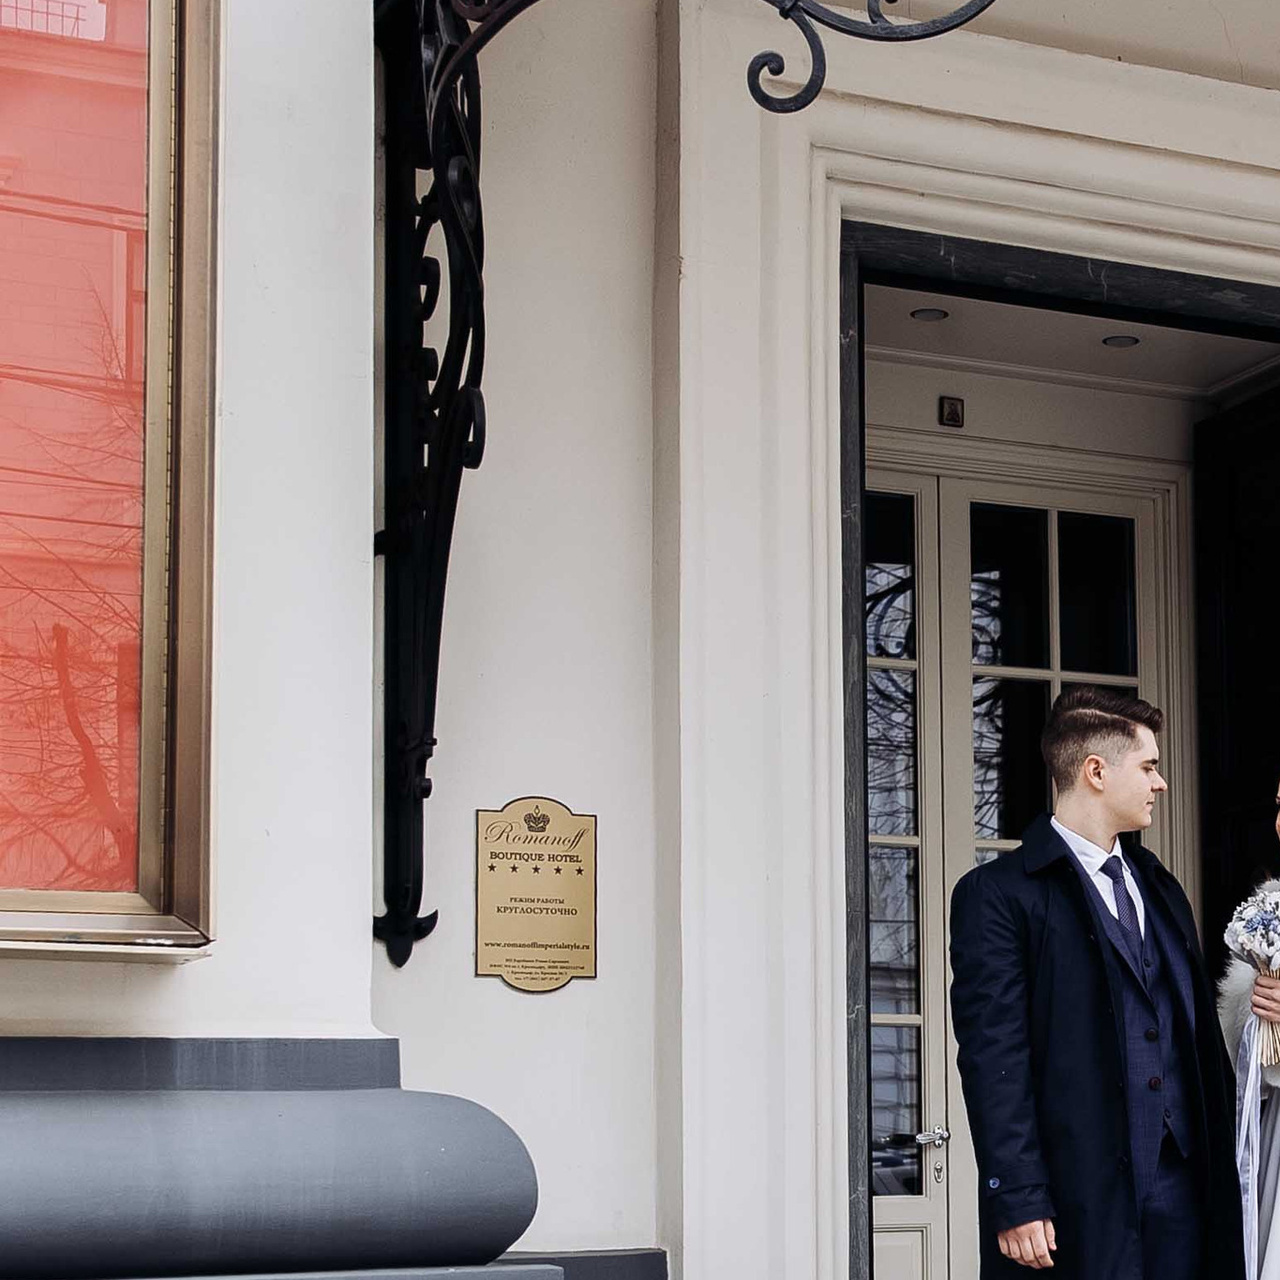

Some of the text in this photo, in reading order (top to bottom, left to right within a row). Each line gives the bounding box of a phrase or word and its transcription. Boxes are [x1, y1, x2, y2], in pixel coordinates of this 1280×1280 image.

[484, 820, 590, 852] Romanoff
[489, 851, 583, 863] BOUTIQUE HOTEL
[496, 906, 578, 916] КРУГЛОСУТОЧНО
